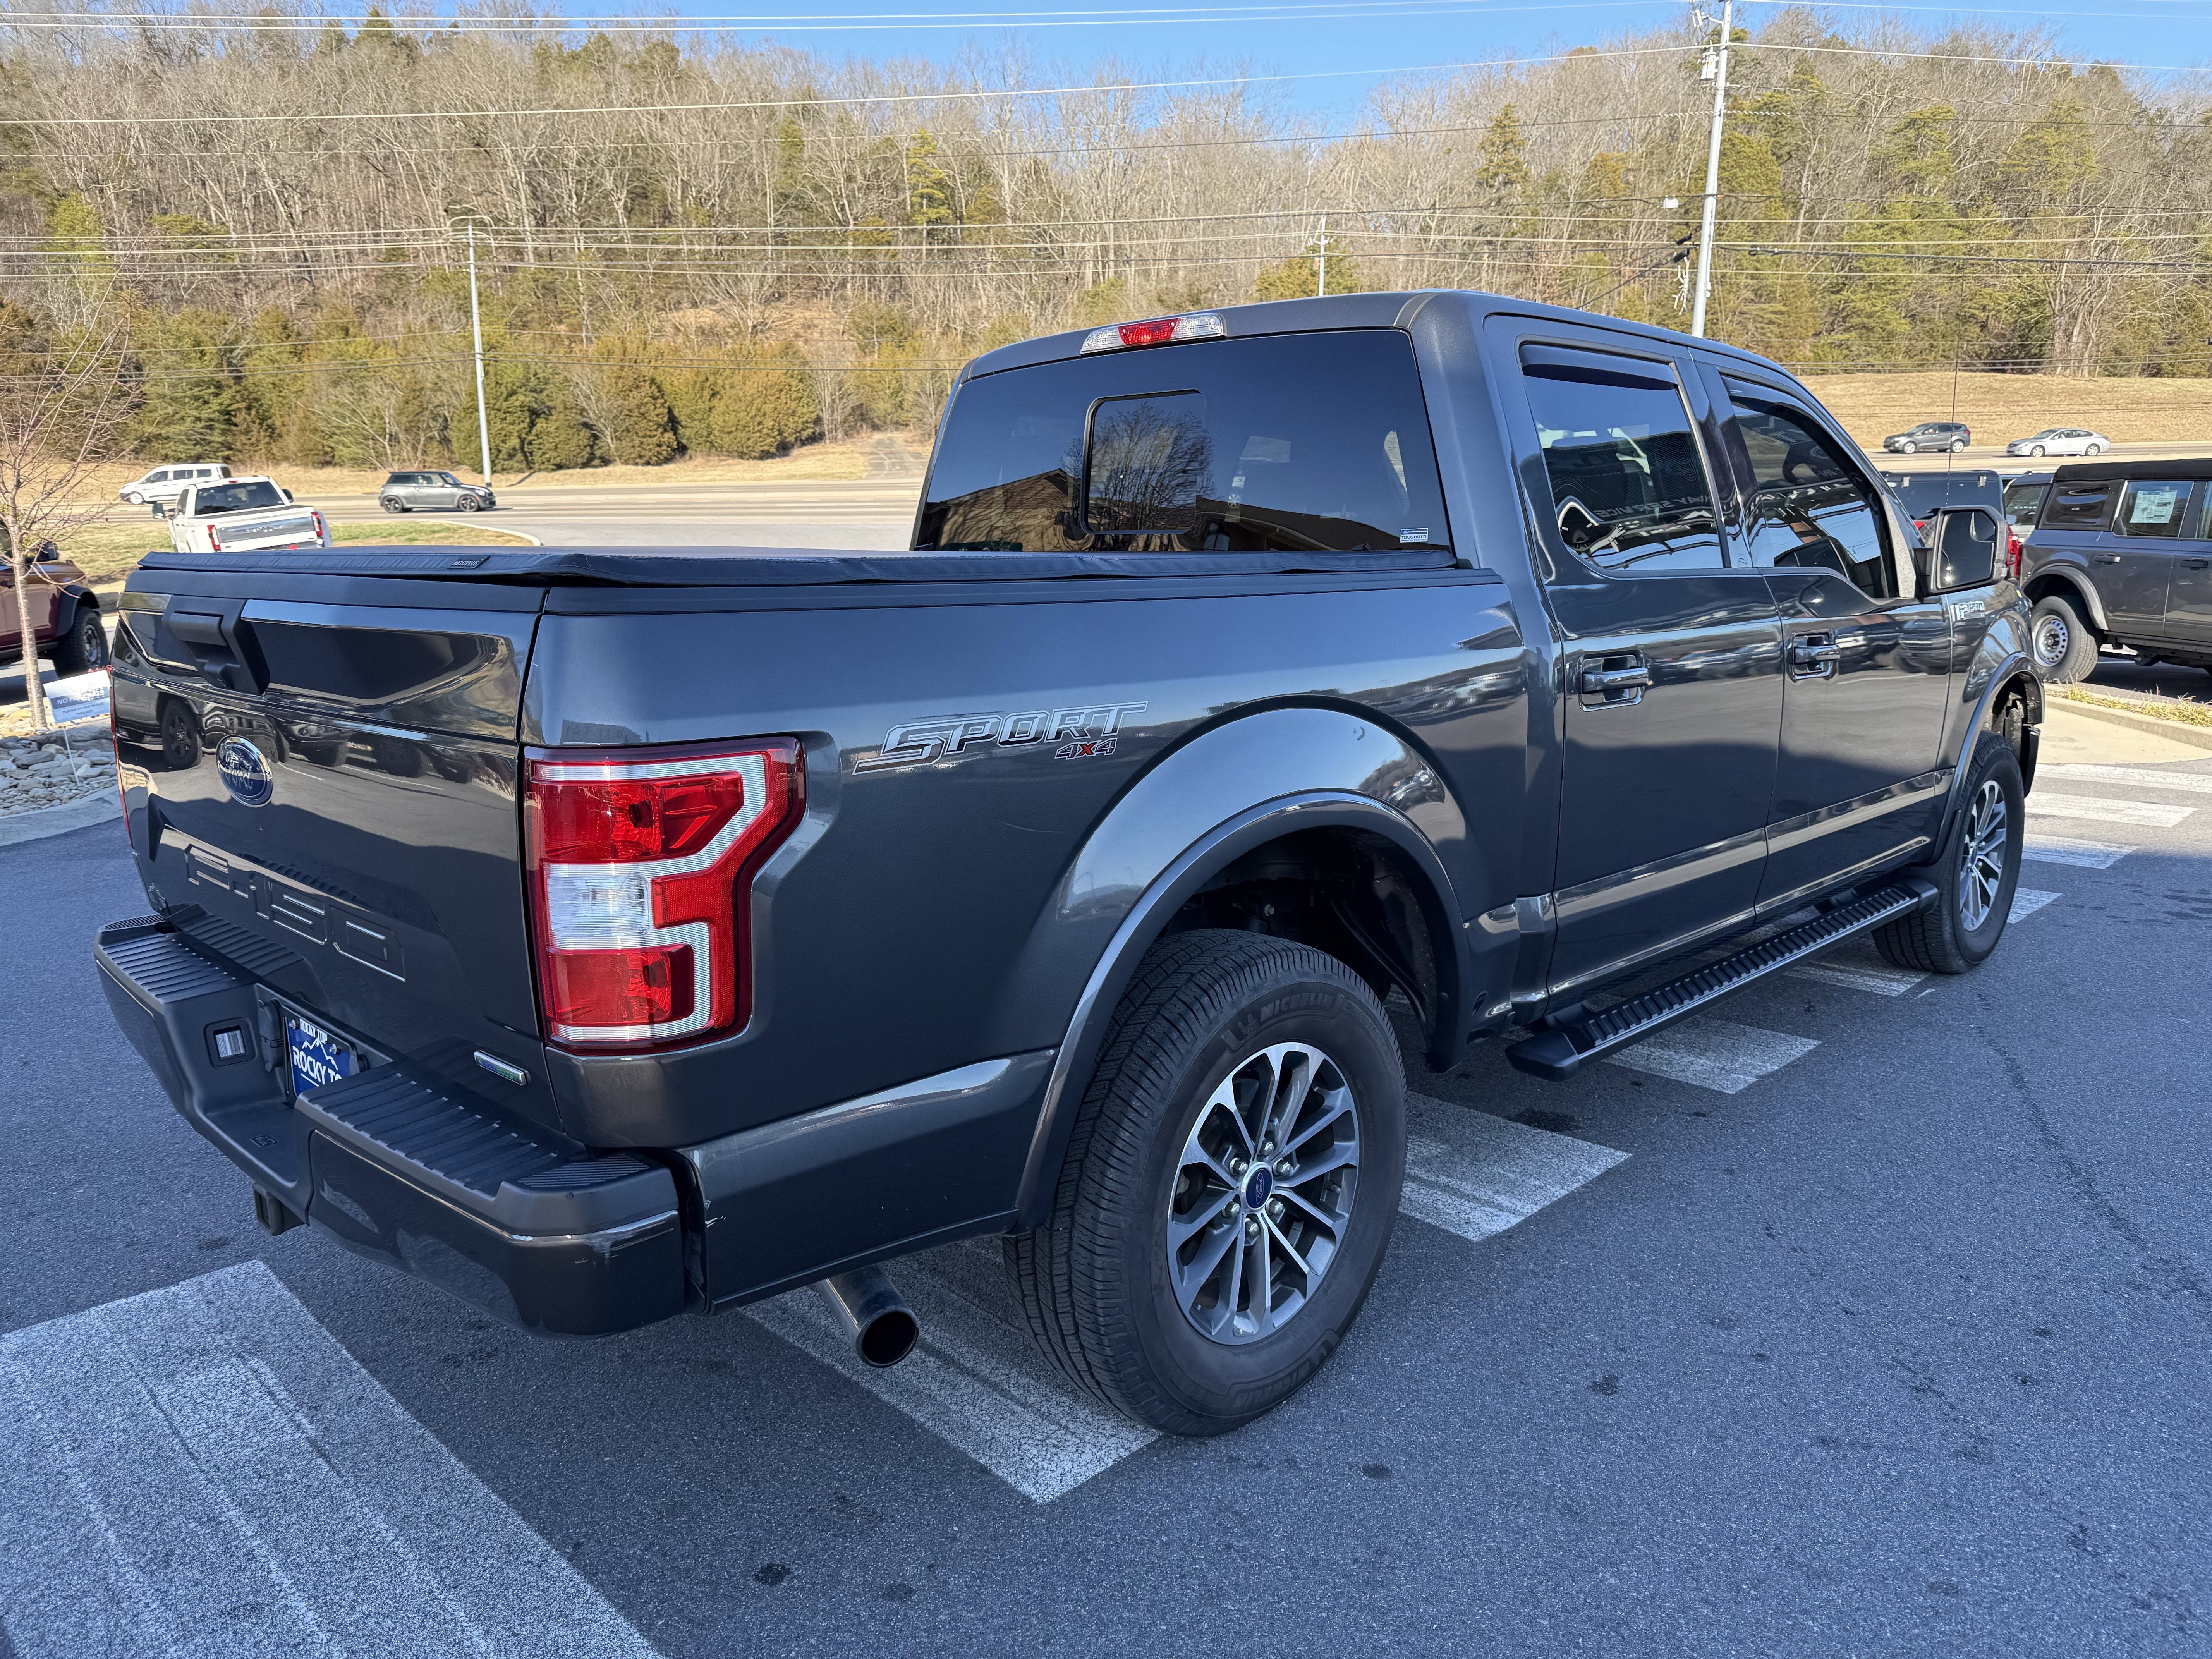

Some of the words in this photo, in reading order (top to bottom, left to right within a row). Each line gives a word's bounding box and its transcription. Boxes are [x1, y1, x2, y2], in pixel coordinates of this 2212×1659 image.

[852, 701, 1149, 776] SPORT
[1260, 992, 1334, 1022] MICHELIN
[299, 1018, 316, 1038] ROCKY
[316, 1029, 328, 1044] TOP
[292, 1046, 326, 1085] ROCKY
